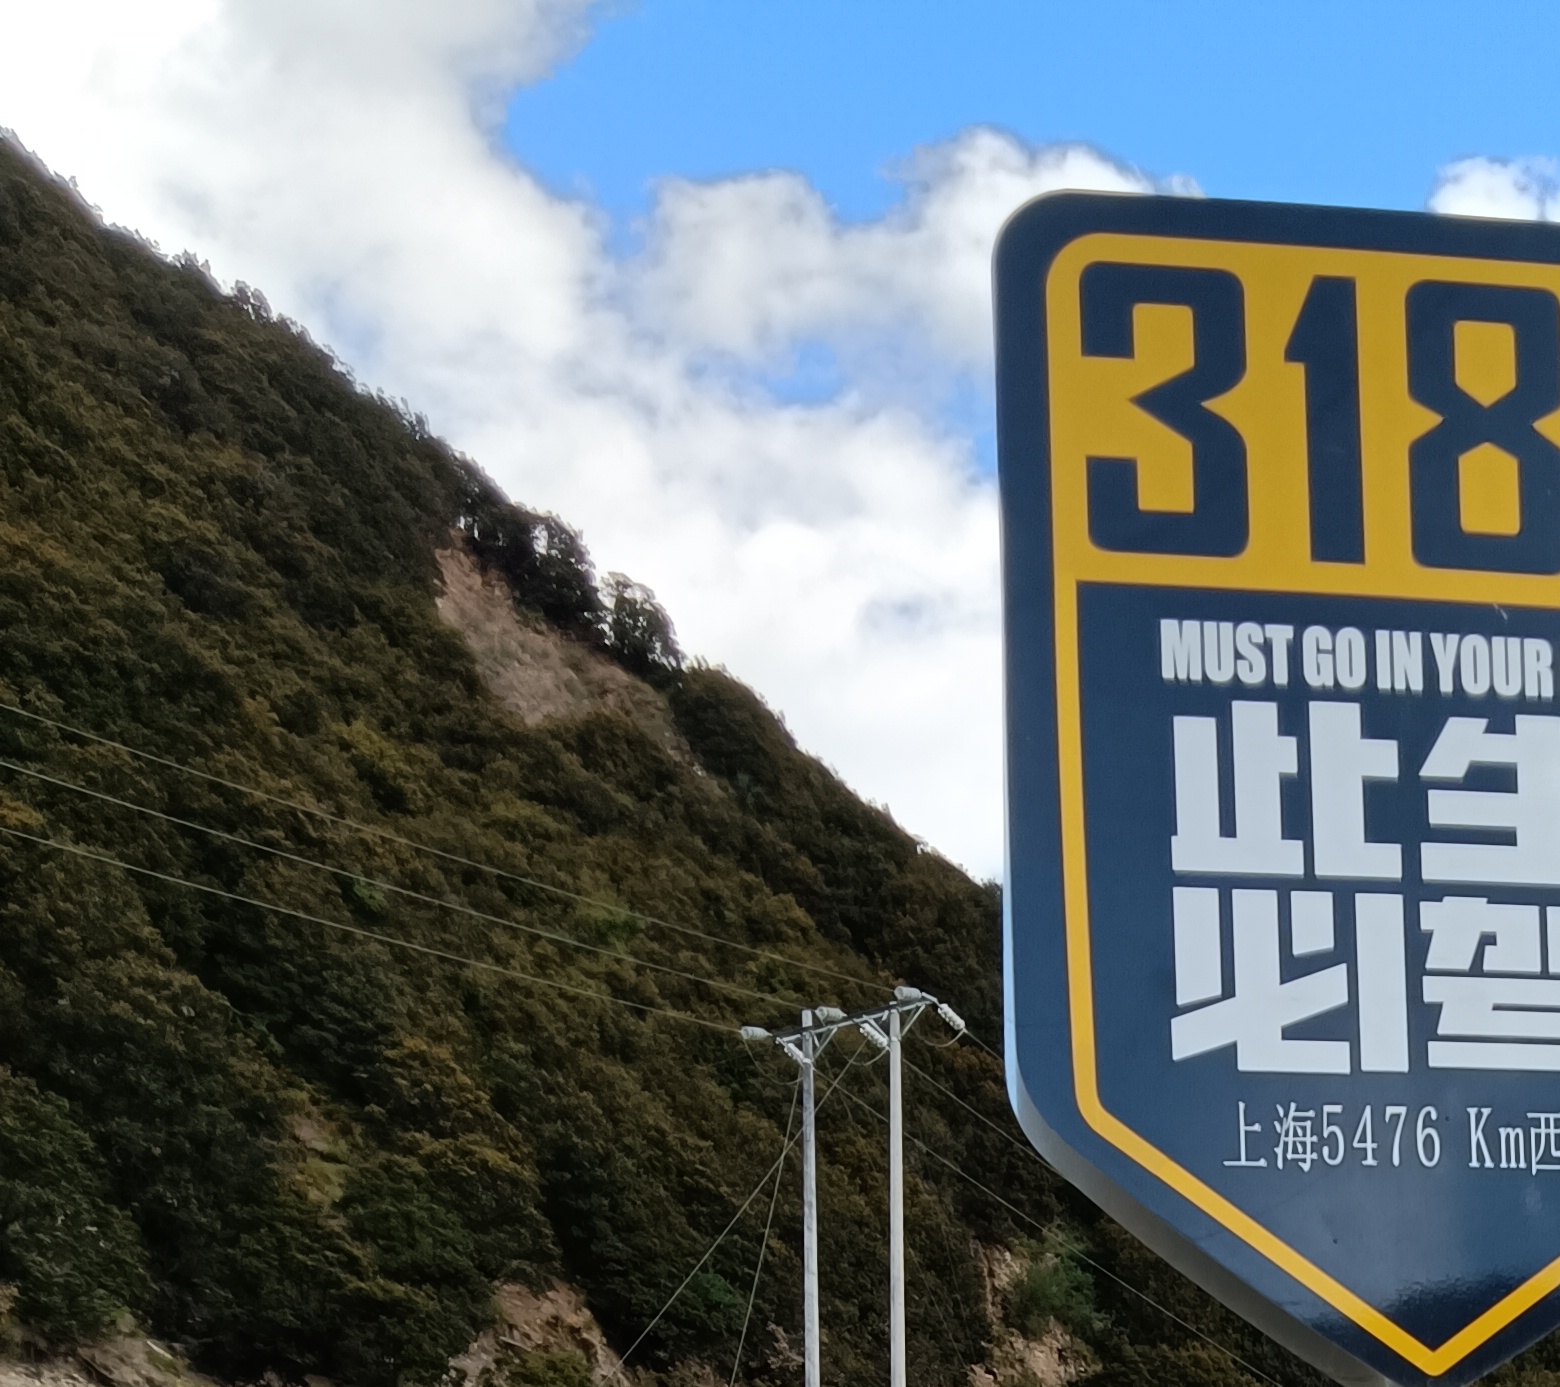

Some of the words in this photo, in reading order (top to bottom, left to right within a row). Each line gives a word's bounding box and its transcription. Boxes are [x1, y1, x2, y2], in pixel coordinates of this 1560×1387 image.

[1160, 619, 1294, 687] MUST
[1302, 626, 1367, 690] GO
[1375, 630, 1424, 693] IN
[1430, 633, 1554, 700] YOUR
[1223, 1101, 1441, 1173] 上海5476
